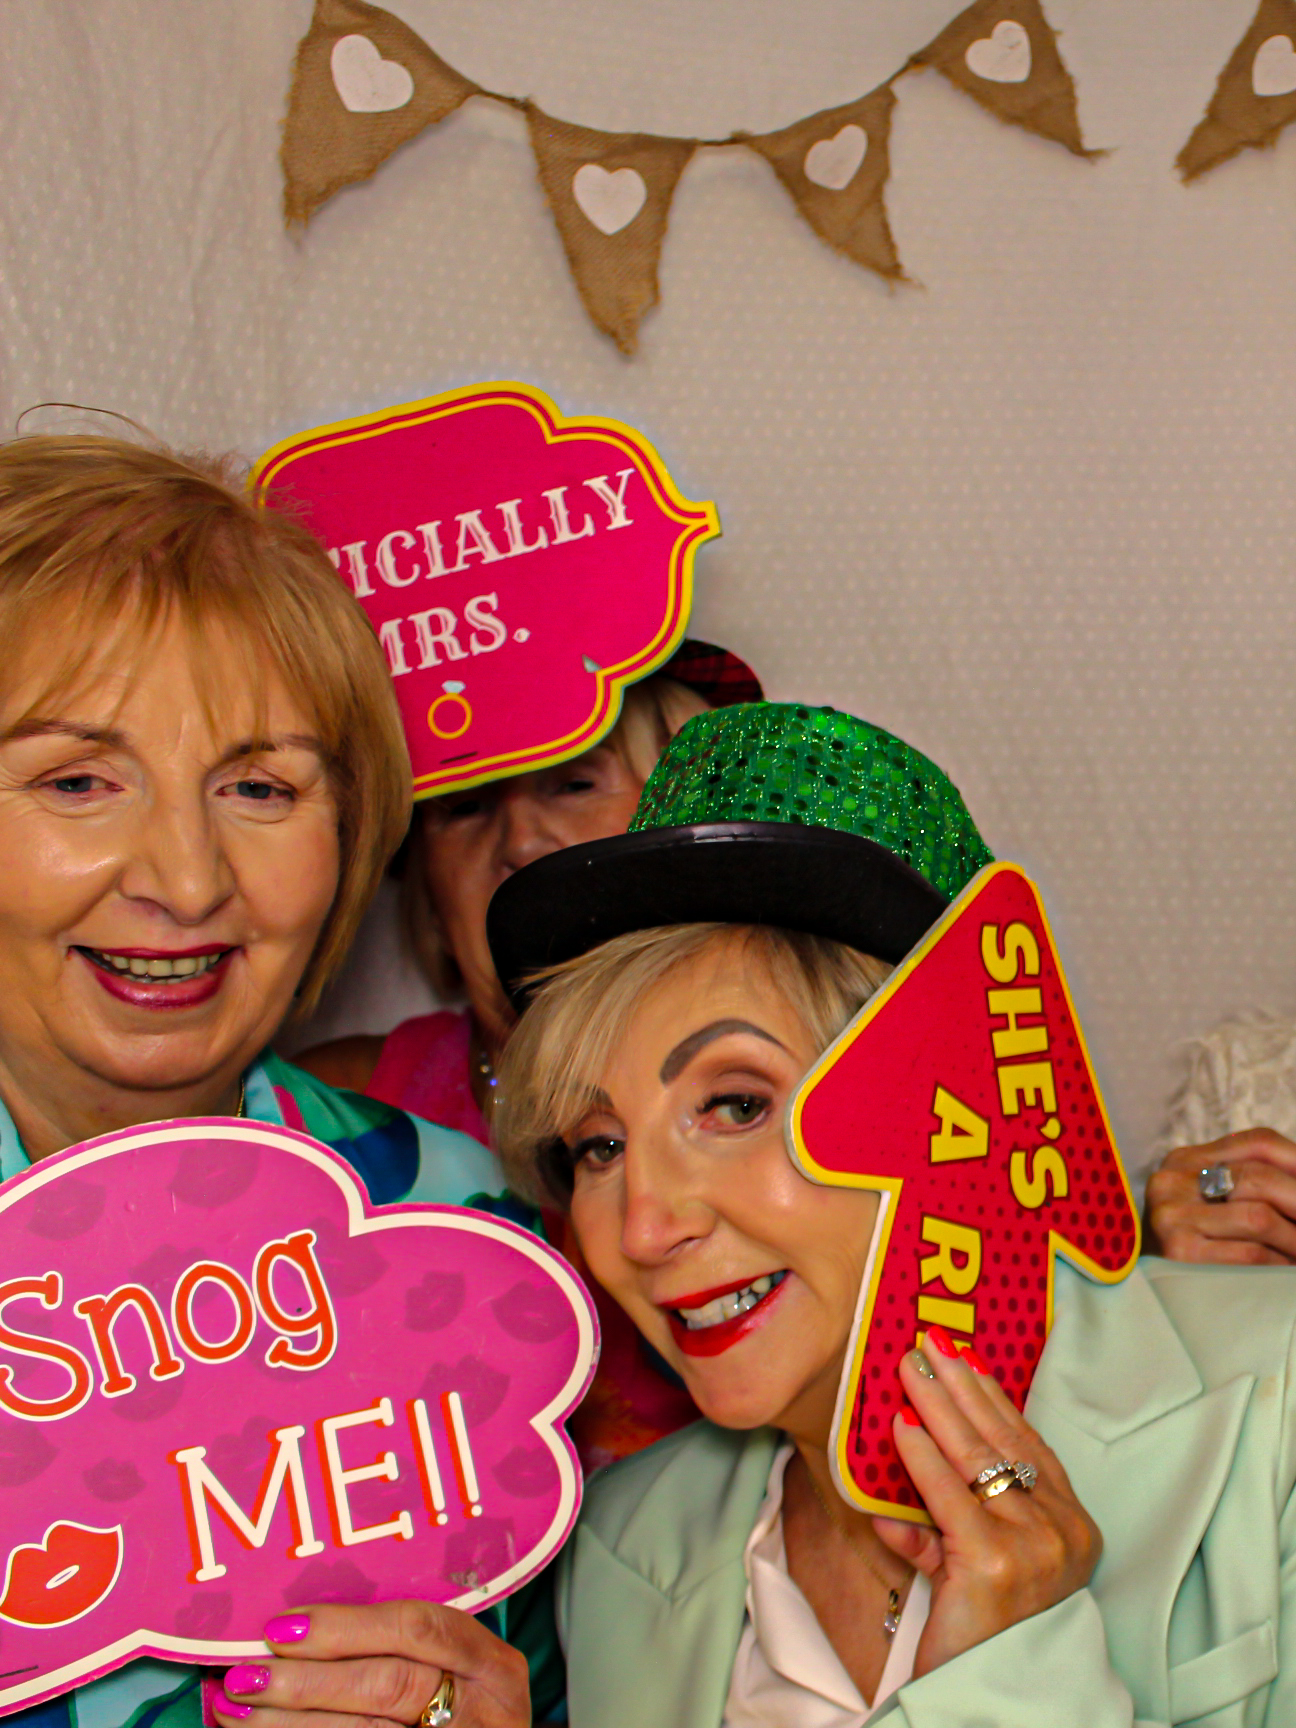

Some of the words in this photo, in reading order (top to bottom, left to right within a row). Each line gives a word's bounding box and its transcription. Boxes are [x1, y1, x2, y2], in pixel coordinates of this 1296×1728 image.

[327, 468, 635, 599] ICIALLY
[930, 1084, 990, 1164] A
[980, 920, 1069, 1209] SHE'S
[0, 1230, 338, 1422] Snog
[916, 1215, 983, 1352] RI
[168, 1391, 483, 1584] ME!!
